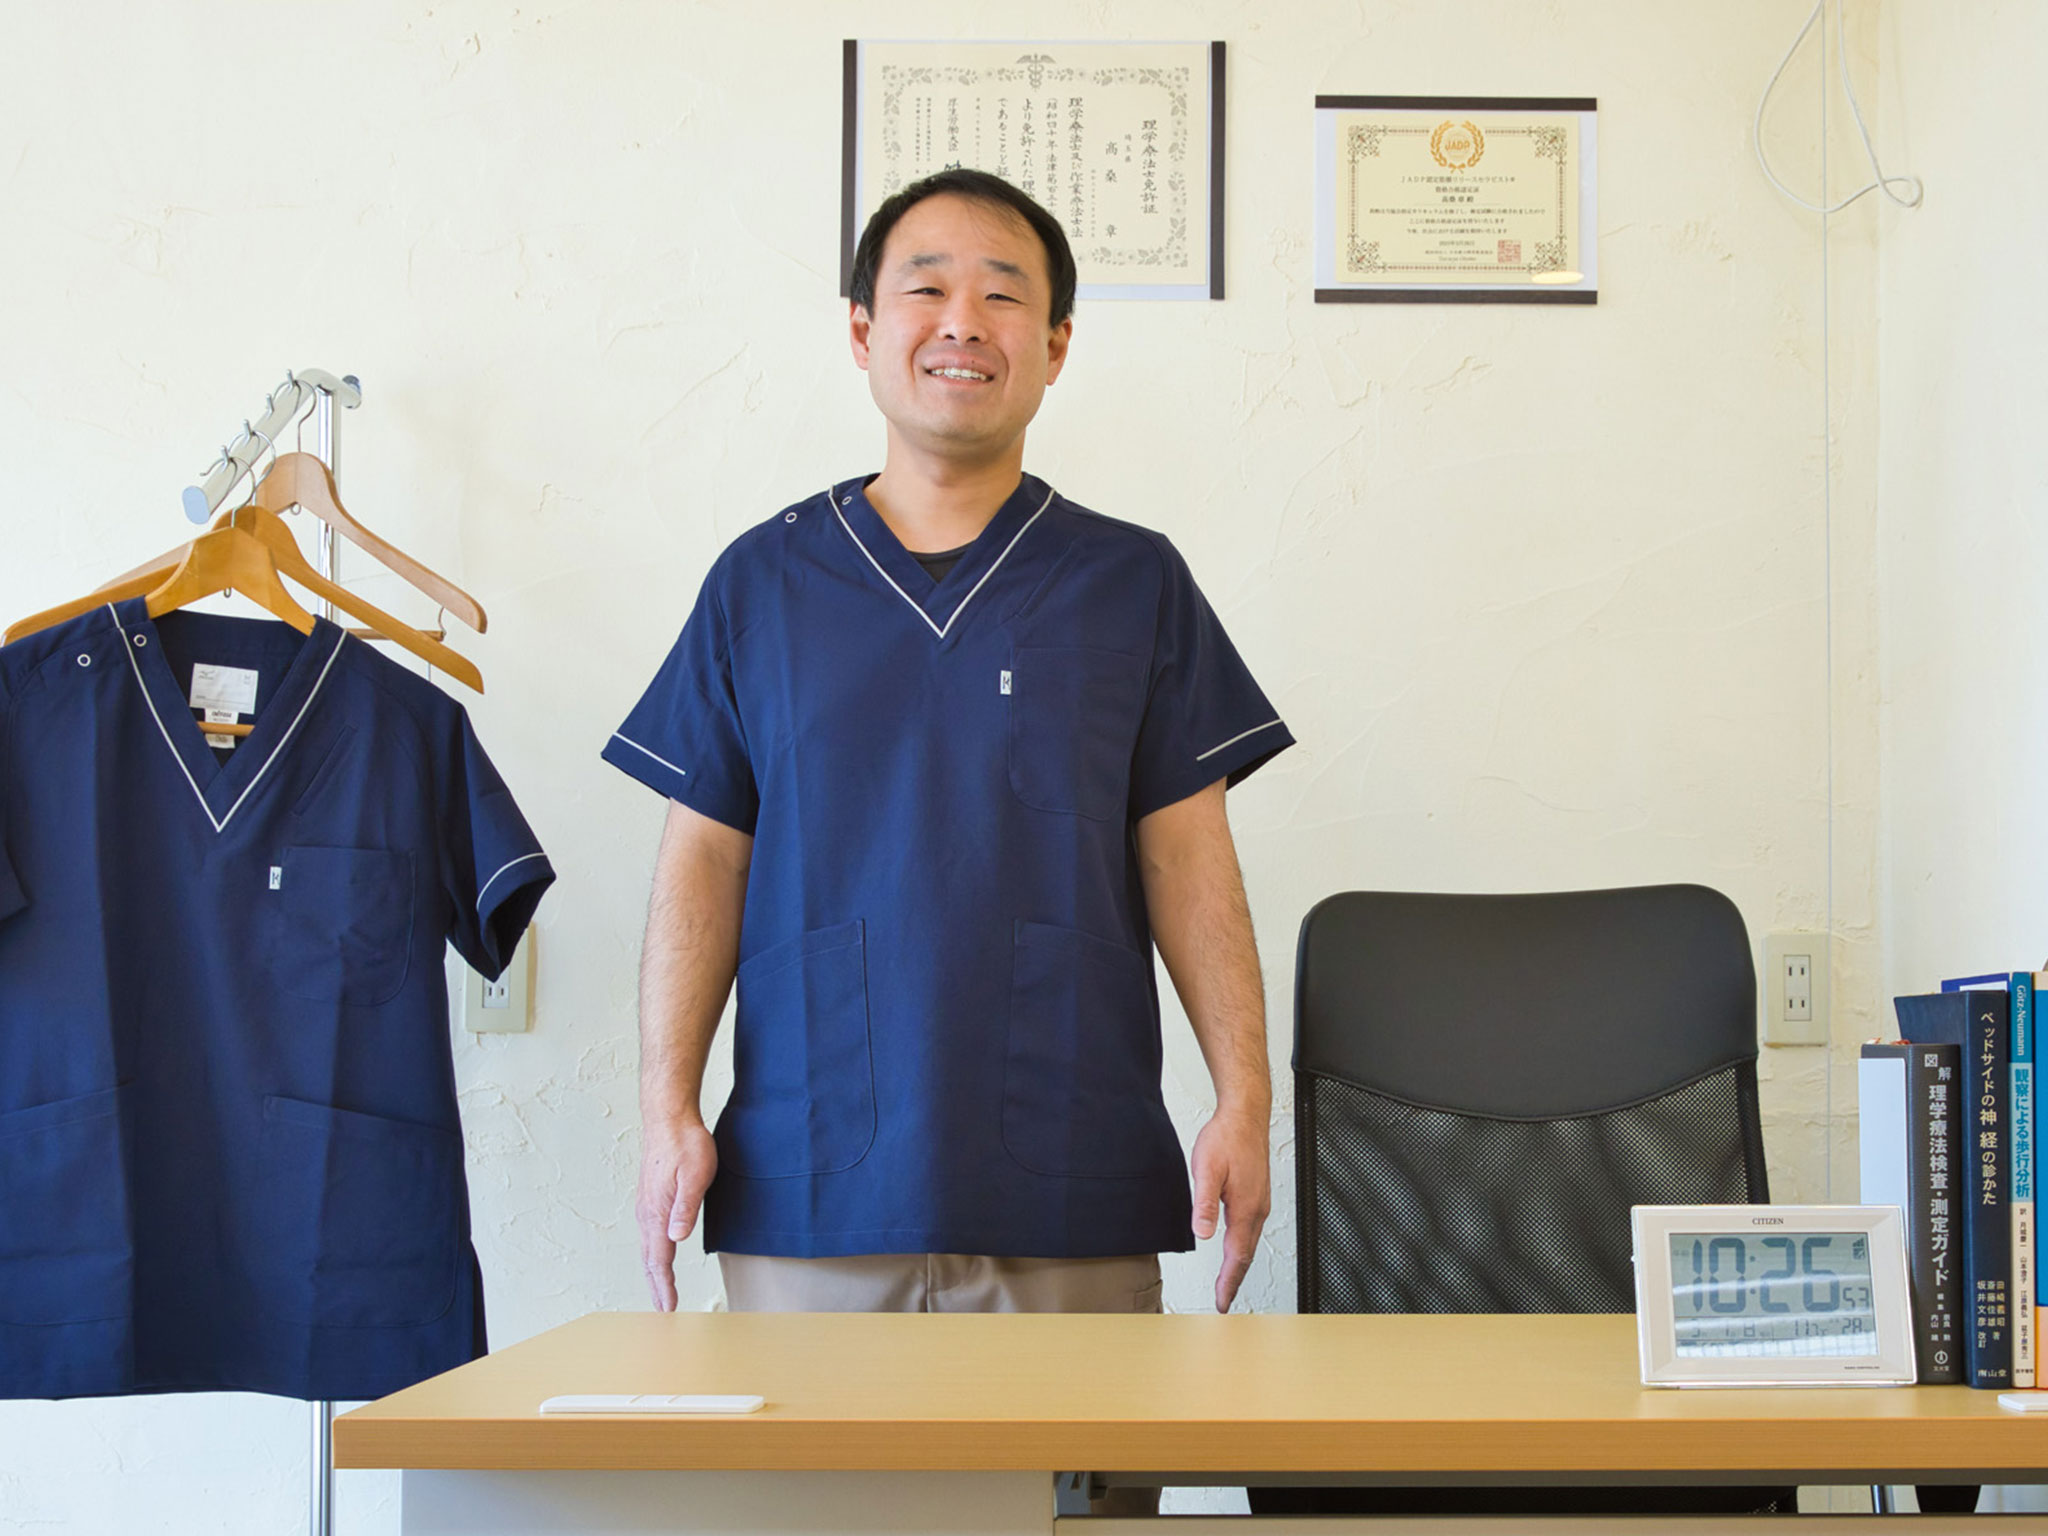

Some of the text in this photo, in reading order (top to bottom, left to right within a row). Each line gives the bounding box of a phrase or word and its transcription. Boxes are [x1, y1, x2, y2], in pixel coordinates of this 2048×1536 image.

[2016, 985, 2027, 1056] Götz-Neumann
[2014, 1068, 2030, 1198] 観察による歩行分析
[1751, 1216, 1784, 1225] CITIZEN
[1929, 1085, 1949, 1287] 理学療法検査・測定ガイド
[1692, 1237, 1841, 1313] 10:26
